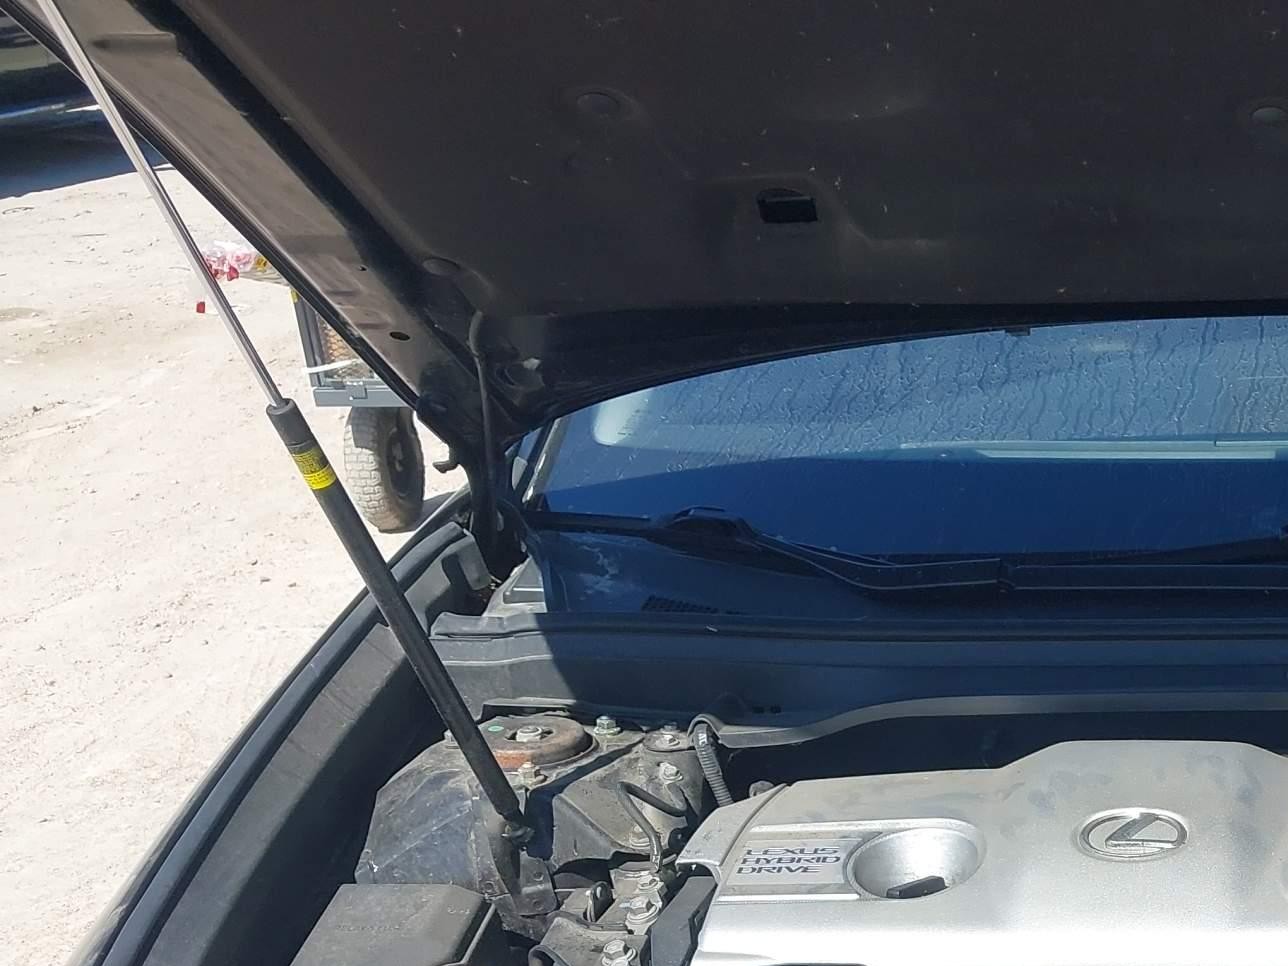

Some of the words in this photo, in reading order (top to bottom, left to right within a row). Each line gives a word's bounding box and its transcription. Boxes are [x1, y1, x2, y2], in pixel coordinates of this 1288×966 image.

[745, 848, 840, 856] LEXUS
[740, 856, 841, 865] HYBRID
[735, 865, 822, 874] DRIVE
